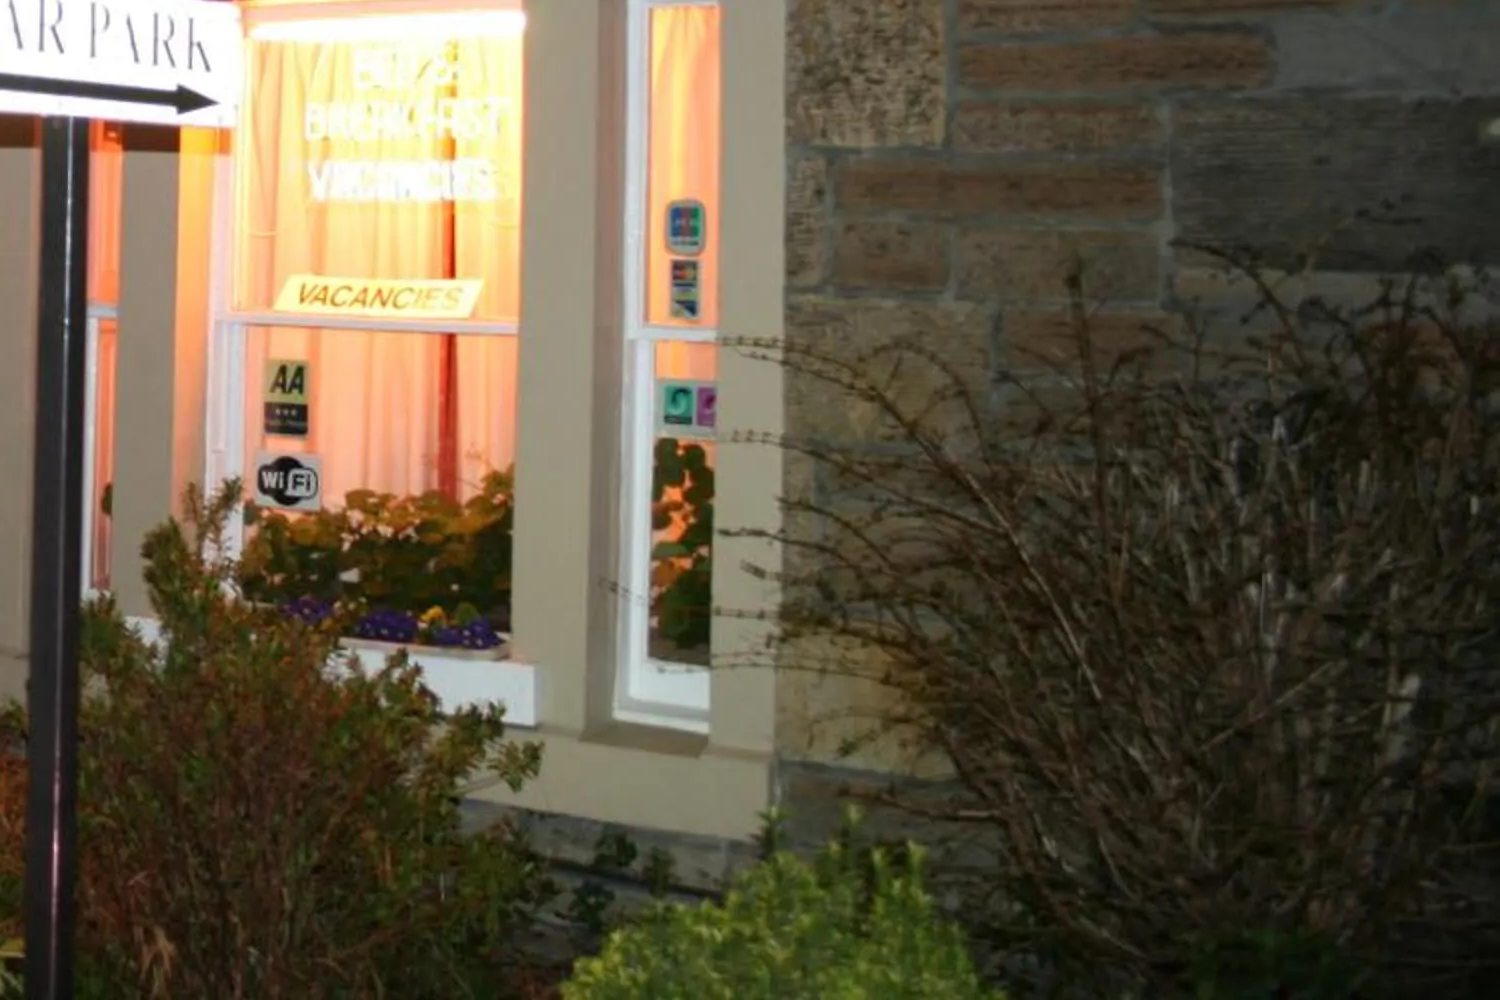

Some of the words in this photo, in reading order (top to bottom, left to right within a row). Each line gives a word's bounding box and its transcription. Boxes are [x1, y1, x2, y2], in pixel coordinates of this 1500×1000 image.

[90, 1, 211, 73] PARK
[298, 282, 464, 311] VACANCIES
[269, 364, 306, 395] AA
